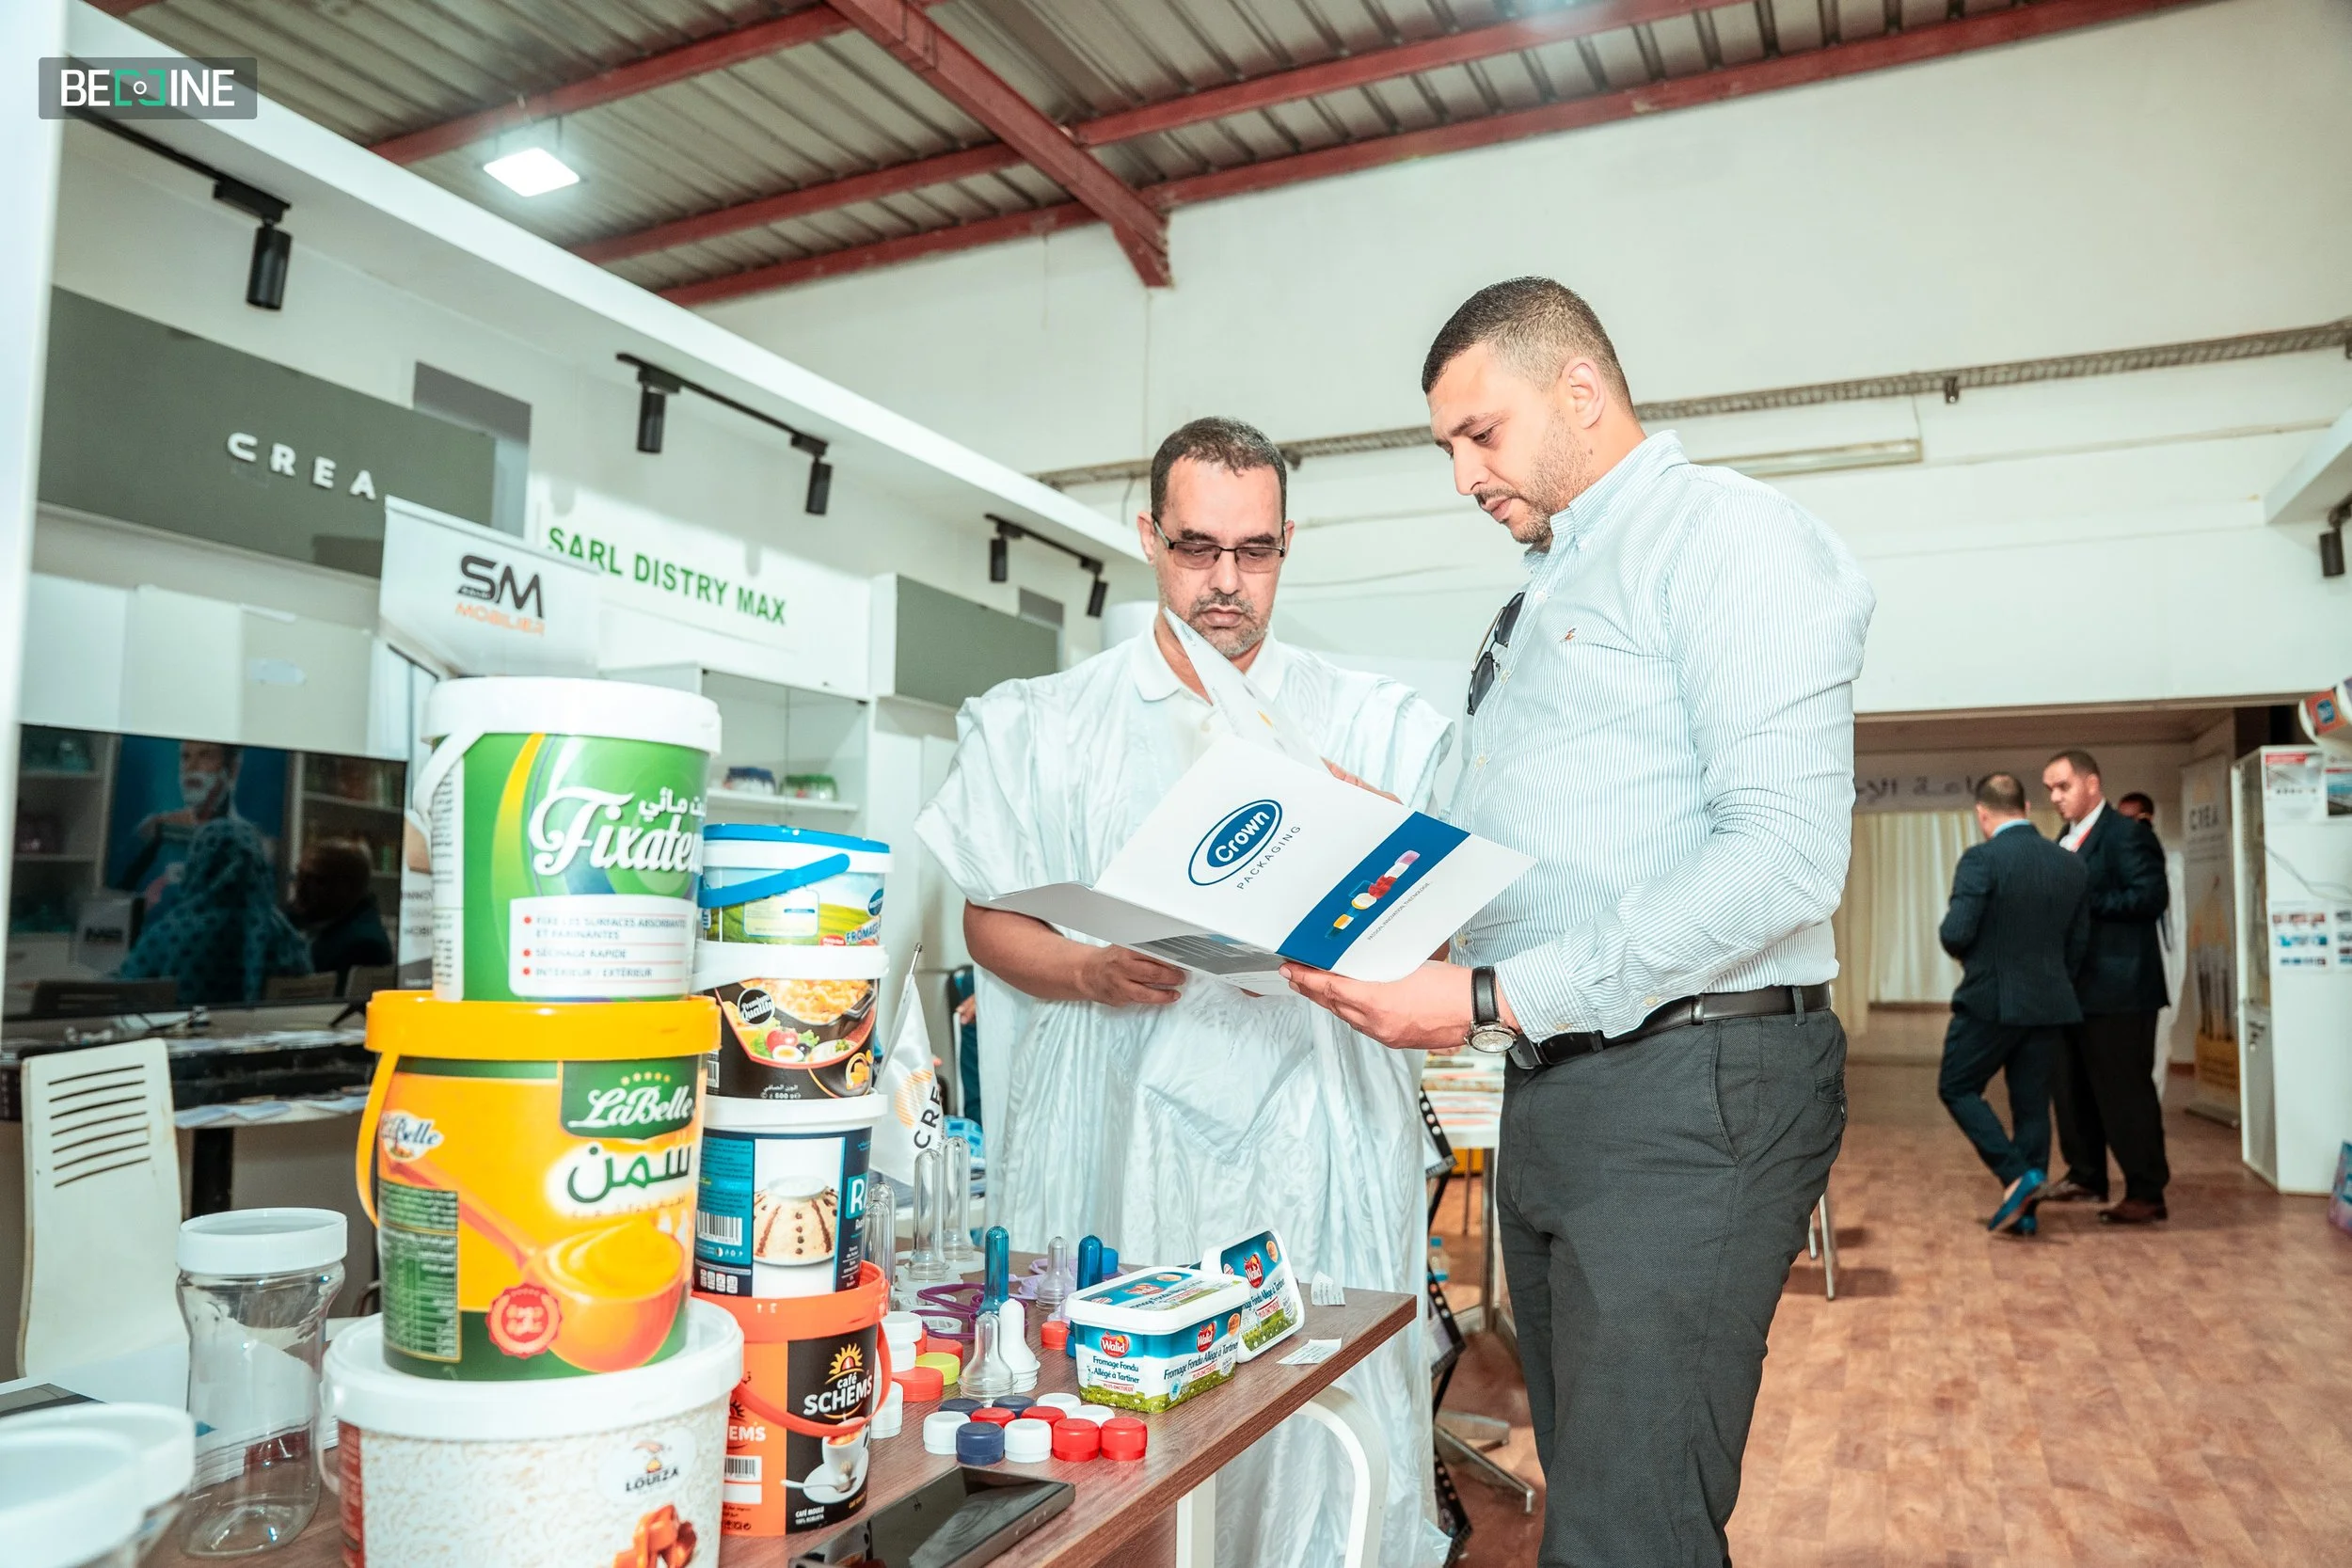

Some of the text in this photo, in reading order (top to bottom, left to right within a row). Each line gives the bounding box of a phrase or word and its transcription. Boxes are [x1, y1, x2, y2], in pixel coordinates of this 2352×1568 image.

[228, 433, 376, 500] CREA
[457, 555, 543, 619] SM
[548, 527, 786, 626] SARL DISTRY MAX
[1216, 811, 1270, 863] Crown
[1236, 826, 1301, 890] PACKAGING
[741, 1001, 773, 1021] Quality
[567, 1085, 694, 1128] LaBelle
[567, 1146, 691, 1204] سمن
[1102, 1338, 1125, 1354] Walid
[1197, 1328, 1214, 1347] Walid
[1092, 1355, 1139, 1372] Fromage Fondu
[1093, 1367, 1111, 1379] Allégé
[1117, 1371, 1140, 1384] Tartiner
[1163, 1364, 1187, 1380] Fromage
[1187, 1354, 1204, 1370] Fondu
[836, 1370, 858, 1390] café
[626, 1466, 678, 1492] LOUIZA
